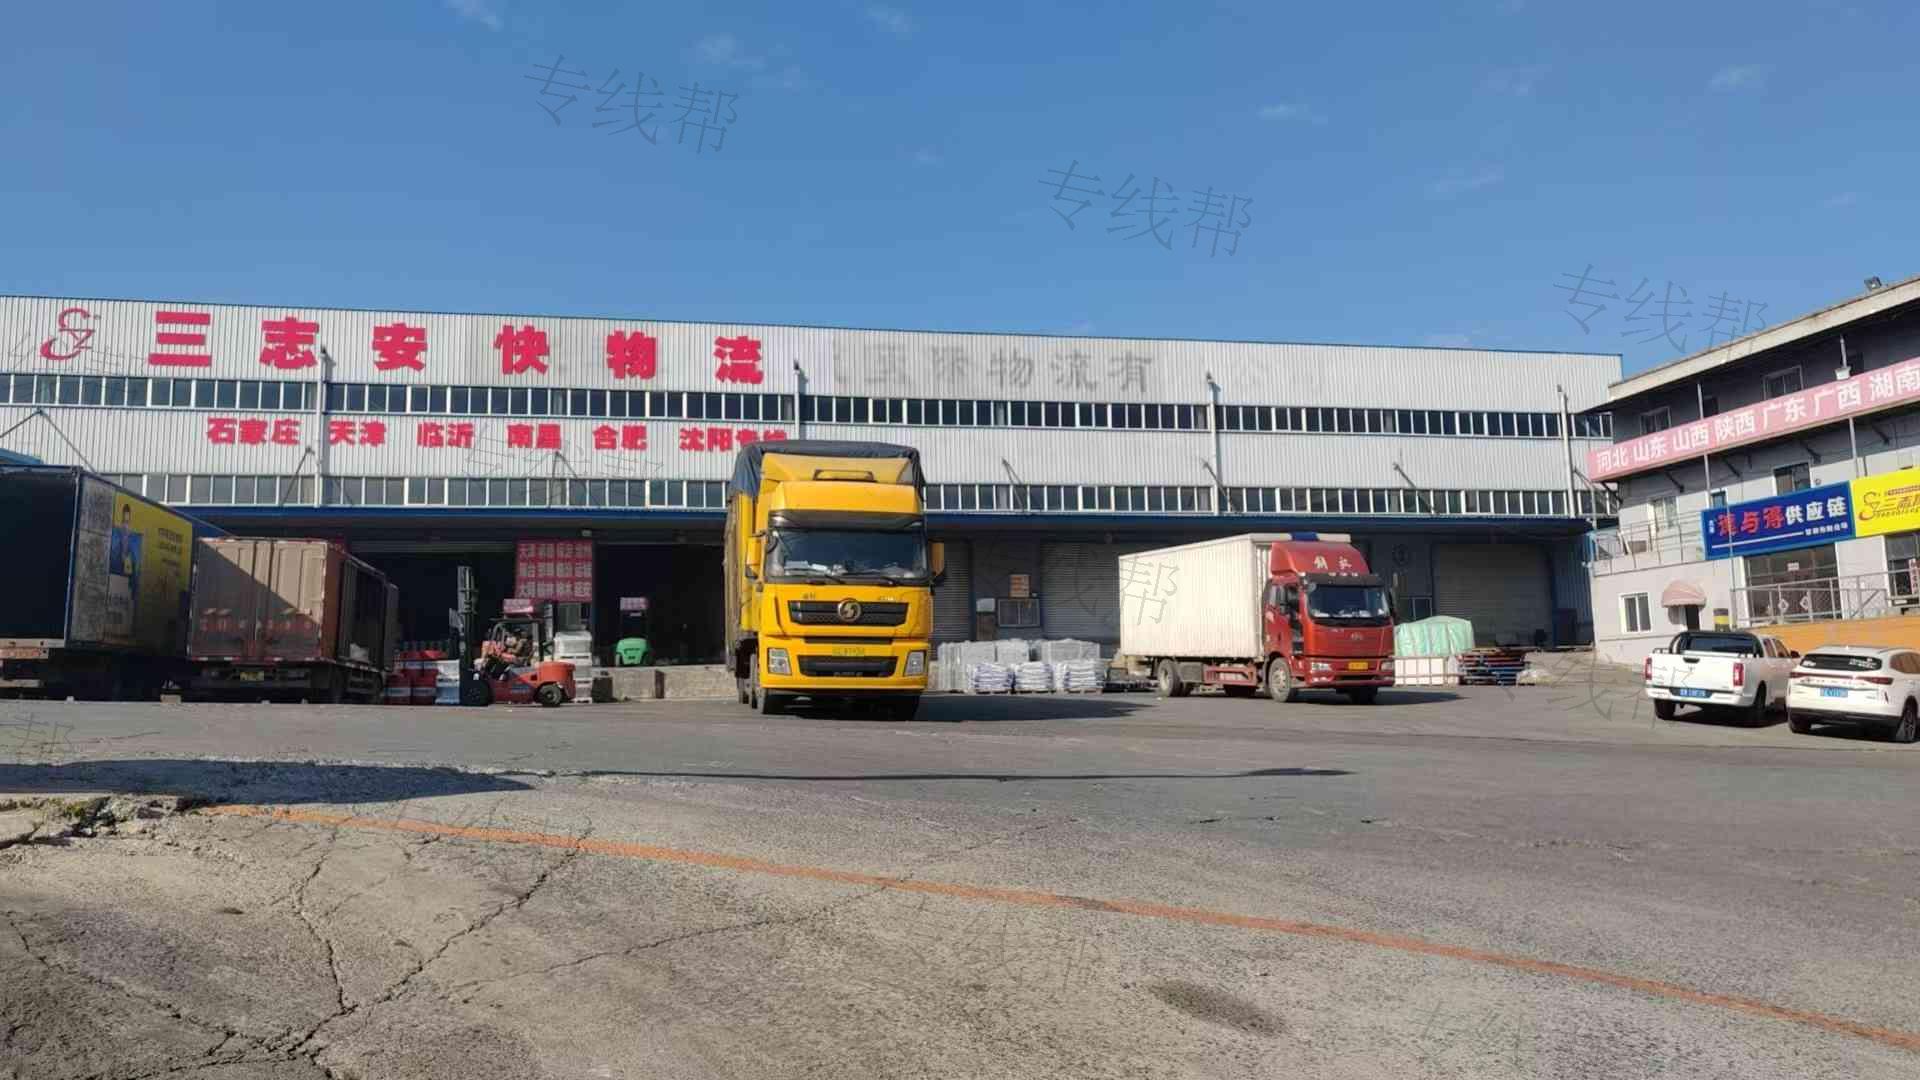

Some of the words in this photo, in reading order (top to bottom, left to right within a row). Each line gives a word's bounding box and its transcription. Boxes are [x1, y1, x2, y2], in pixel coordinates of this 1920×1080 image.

[149, 311, 764, 385] 三志安快物流
[208, 418, 298, 446] 石家庄
[330, 420, 386, 447] 天津
[417, 422, 473, 448] 临沂
[507, 422, 561, 449] 南昌
[593, 425, 647, 450] 合肥
[1596, 448, 1628, 474] 河北
[1634, 437, 1668, 463] 山东
[1673, 423, 1710, 452] 山西
[1714, 409, 1756, 442] 陕西
[1763, 397, 1807, 429] 广东
[1814, 380, 1862, 416] 广西
[1870, 364, 1920, 402] 湖南
